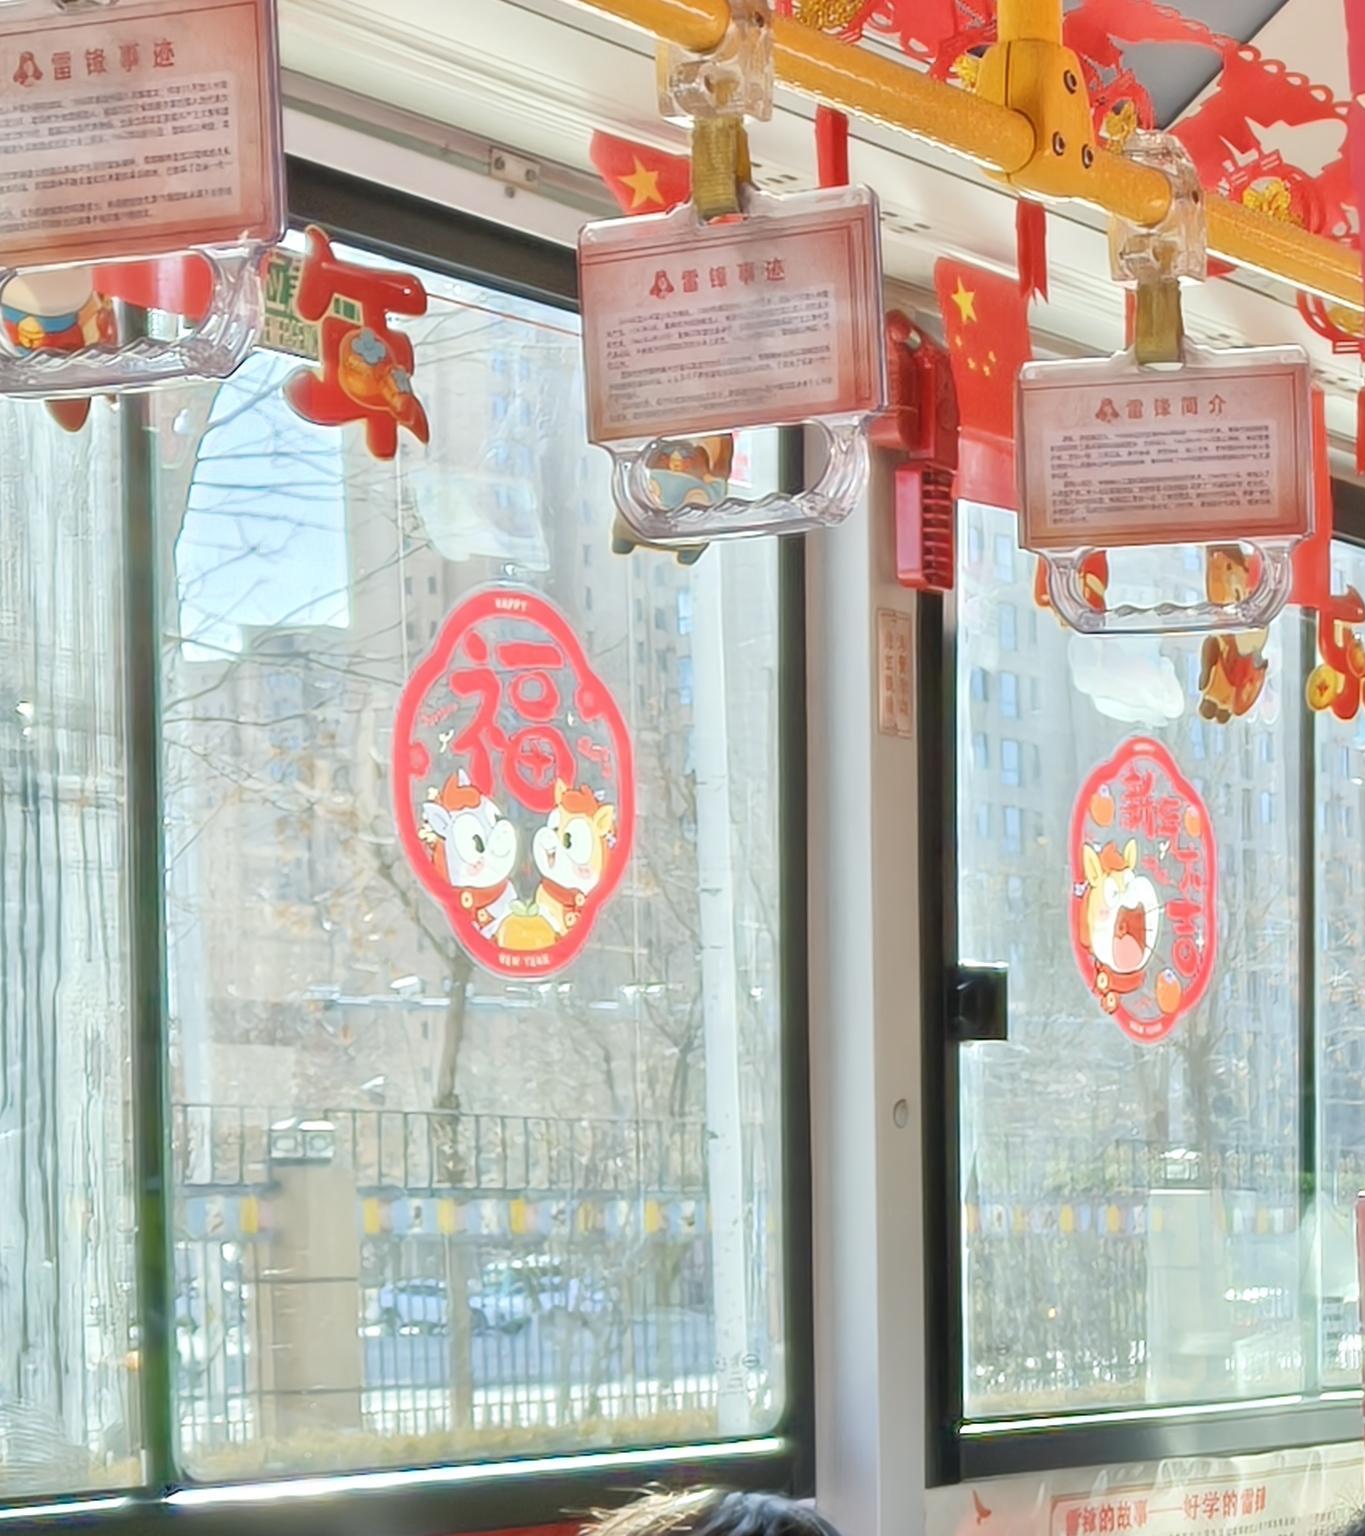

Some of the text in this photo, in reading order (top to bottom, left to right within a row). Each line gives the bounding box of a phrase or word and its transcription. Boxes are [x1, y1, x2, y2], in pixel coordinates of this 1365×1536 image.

[52, 38, 175, 81] 雷锋事迹
[682, 257, 786, 293] 雷锋事迹
[449, 629, 576, 814] 福
